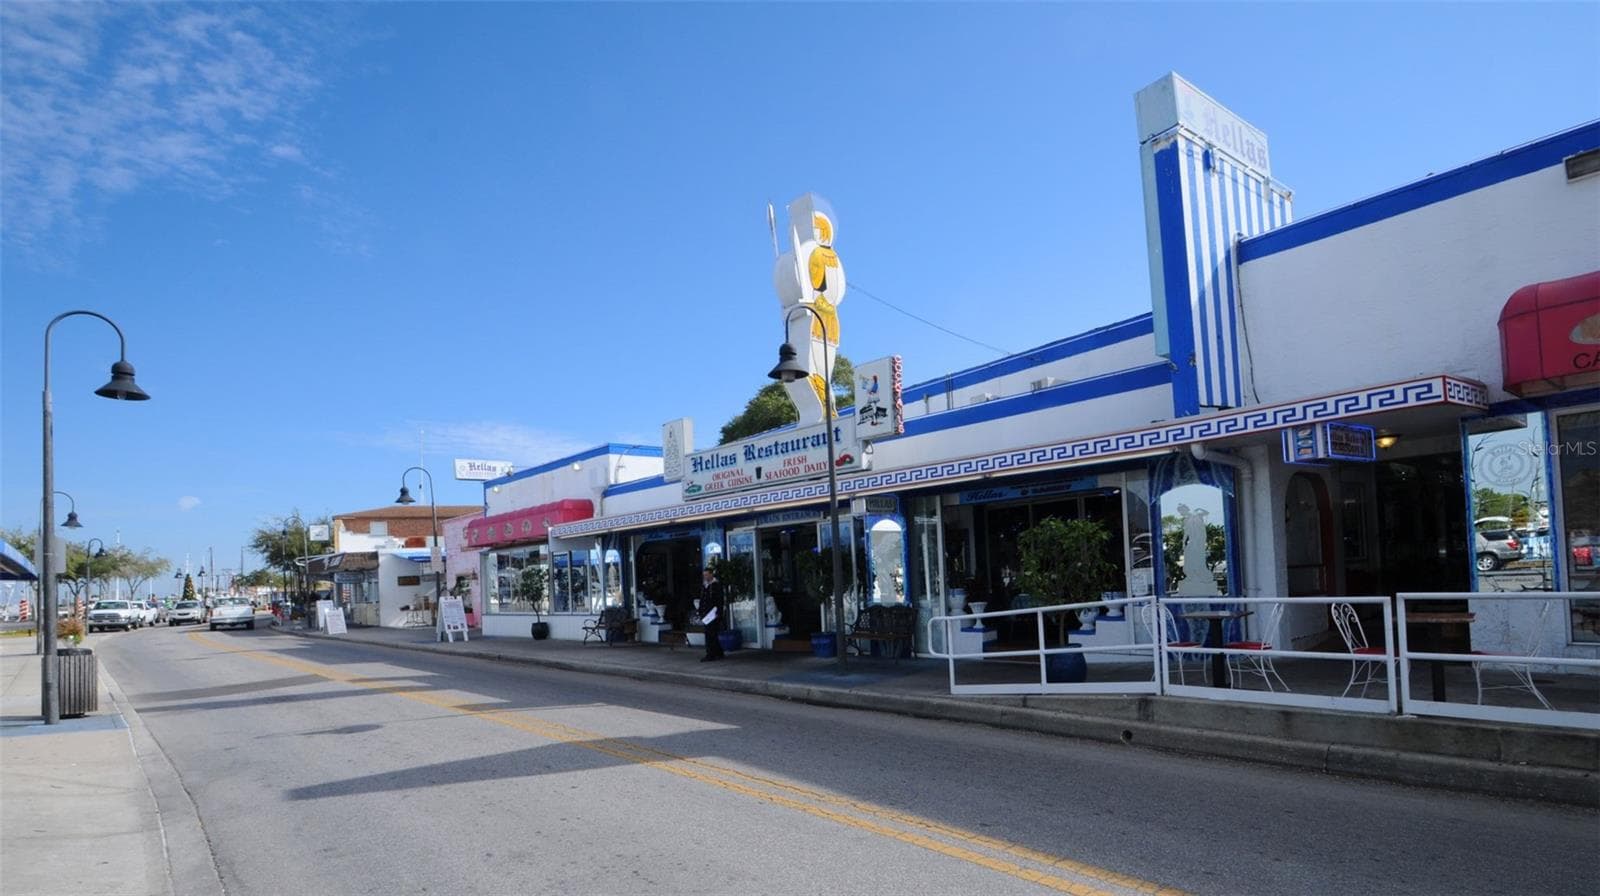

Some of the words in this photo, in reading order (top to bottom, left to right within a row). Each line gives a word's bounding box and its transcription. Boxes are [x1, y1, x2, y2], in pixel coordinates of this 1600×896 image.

[1202, 106, 1268, 170] Hellas
[467, 462, 497, 472] Hellas
[691, 453, 737, 473] Hellas
[783, 455, 808, 467] FRESH
[712, 468, 744, 481] ORIGINAL
[764, 467, 800, 481] SEAFOOD
[804, 461, 827, 474] DAILY
[704, 481, 725, 491] GREEK
[728, 476, 752, 488] CUISINE
